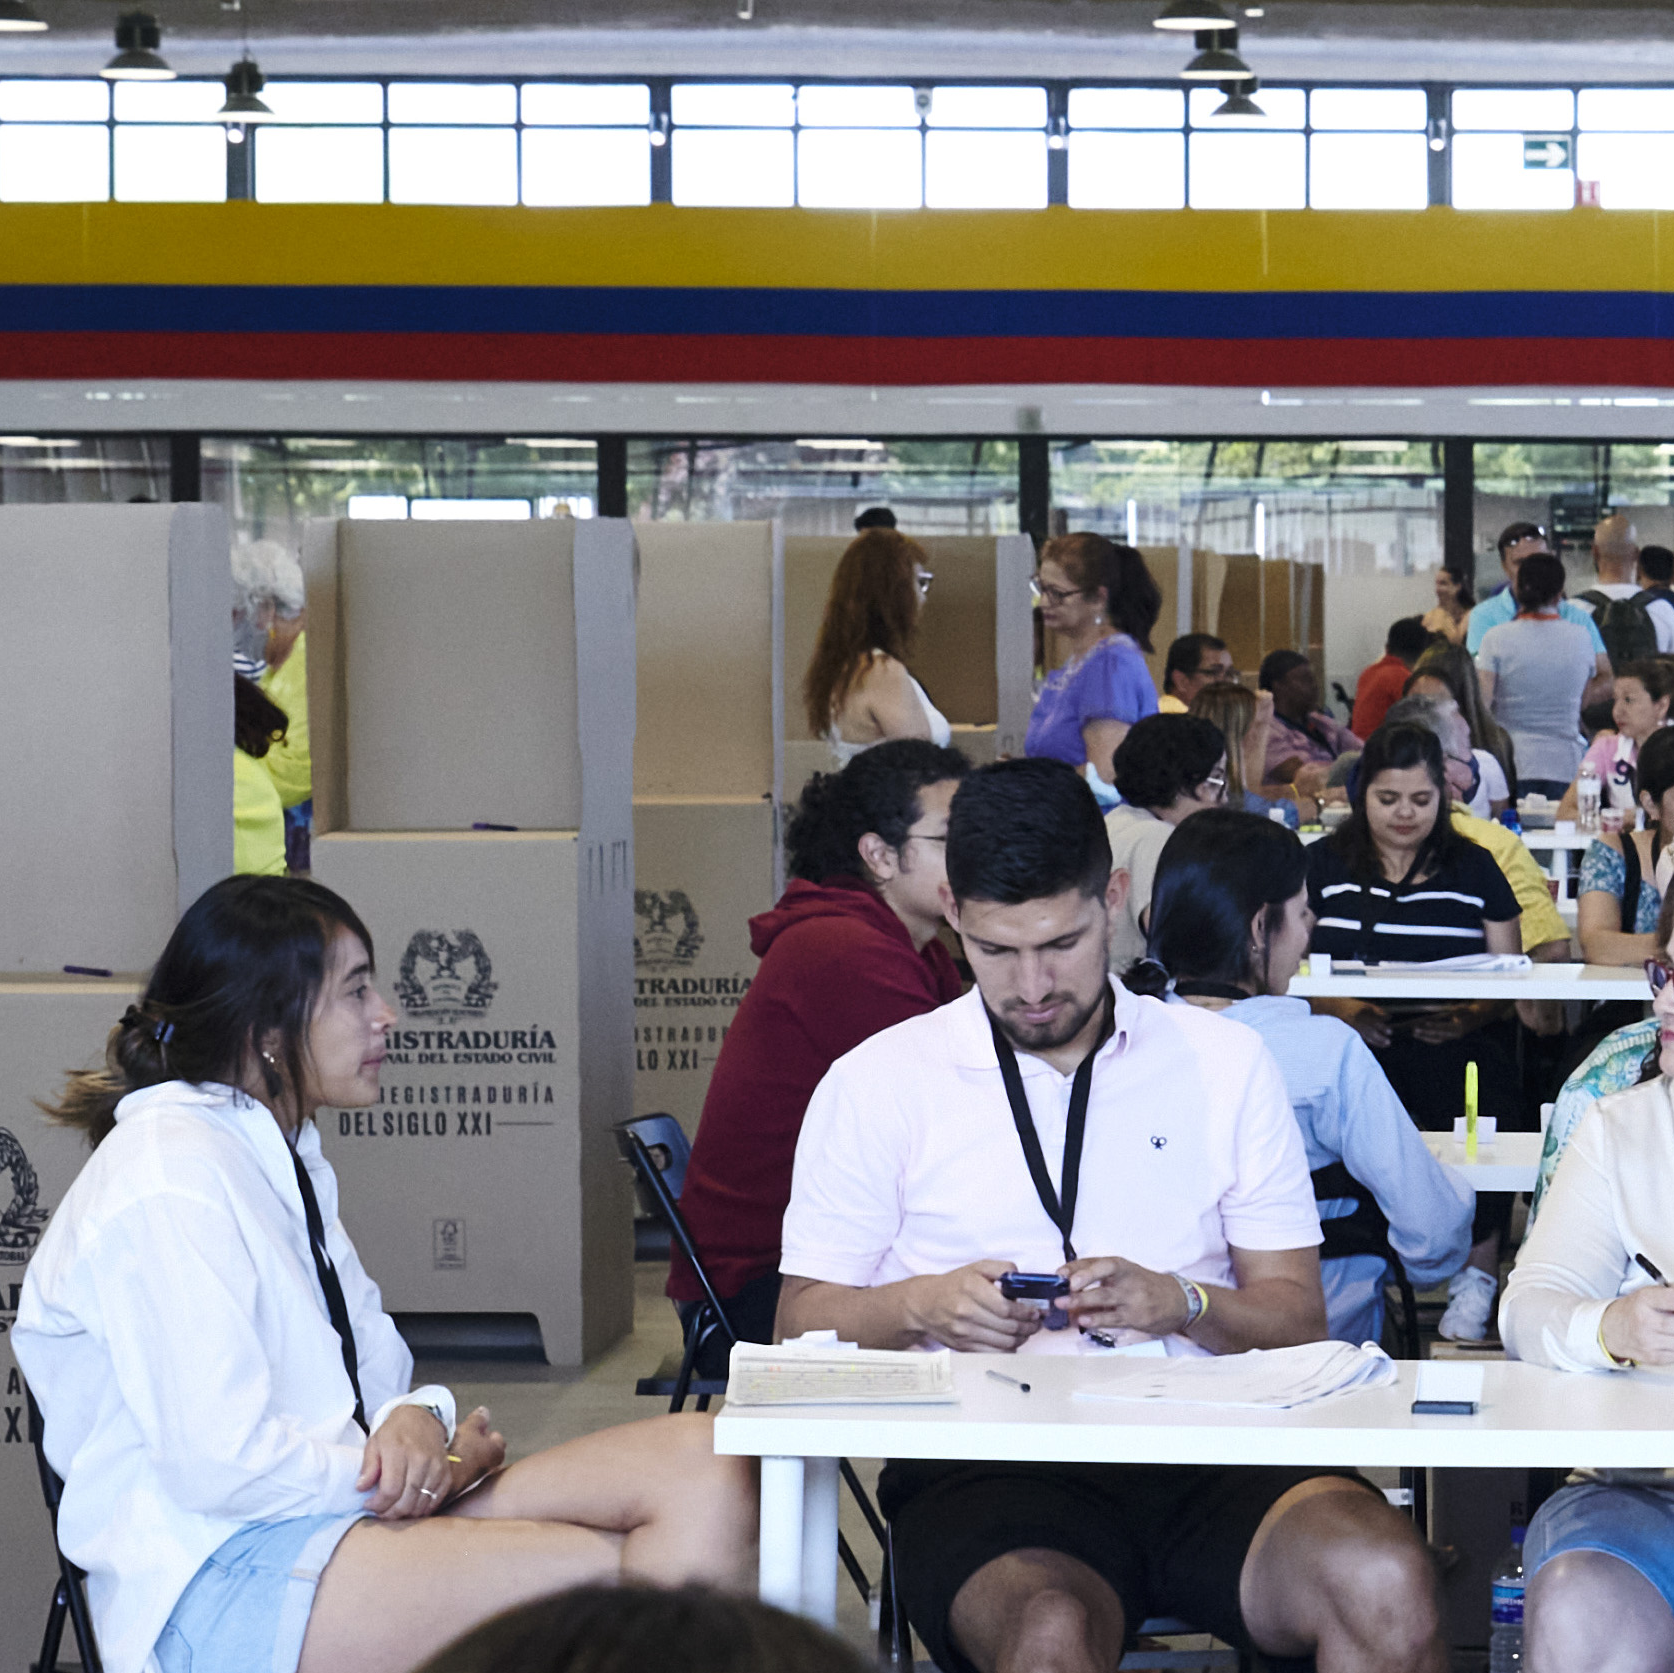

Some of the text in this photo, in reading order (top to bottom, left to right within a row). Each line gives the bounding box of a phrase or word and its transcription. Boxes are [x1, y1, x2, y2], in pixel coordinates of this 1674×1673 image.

[418, 1052, 447, 1064] DEL
[453, 1052, 513, 1064] ESTADO
[517, 1052, 557, 1064] CIVIL
[667, 1049, 698, 1071] XXI
[339, 1111, 492, 1136] DEL SIGLO XXI
